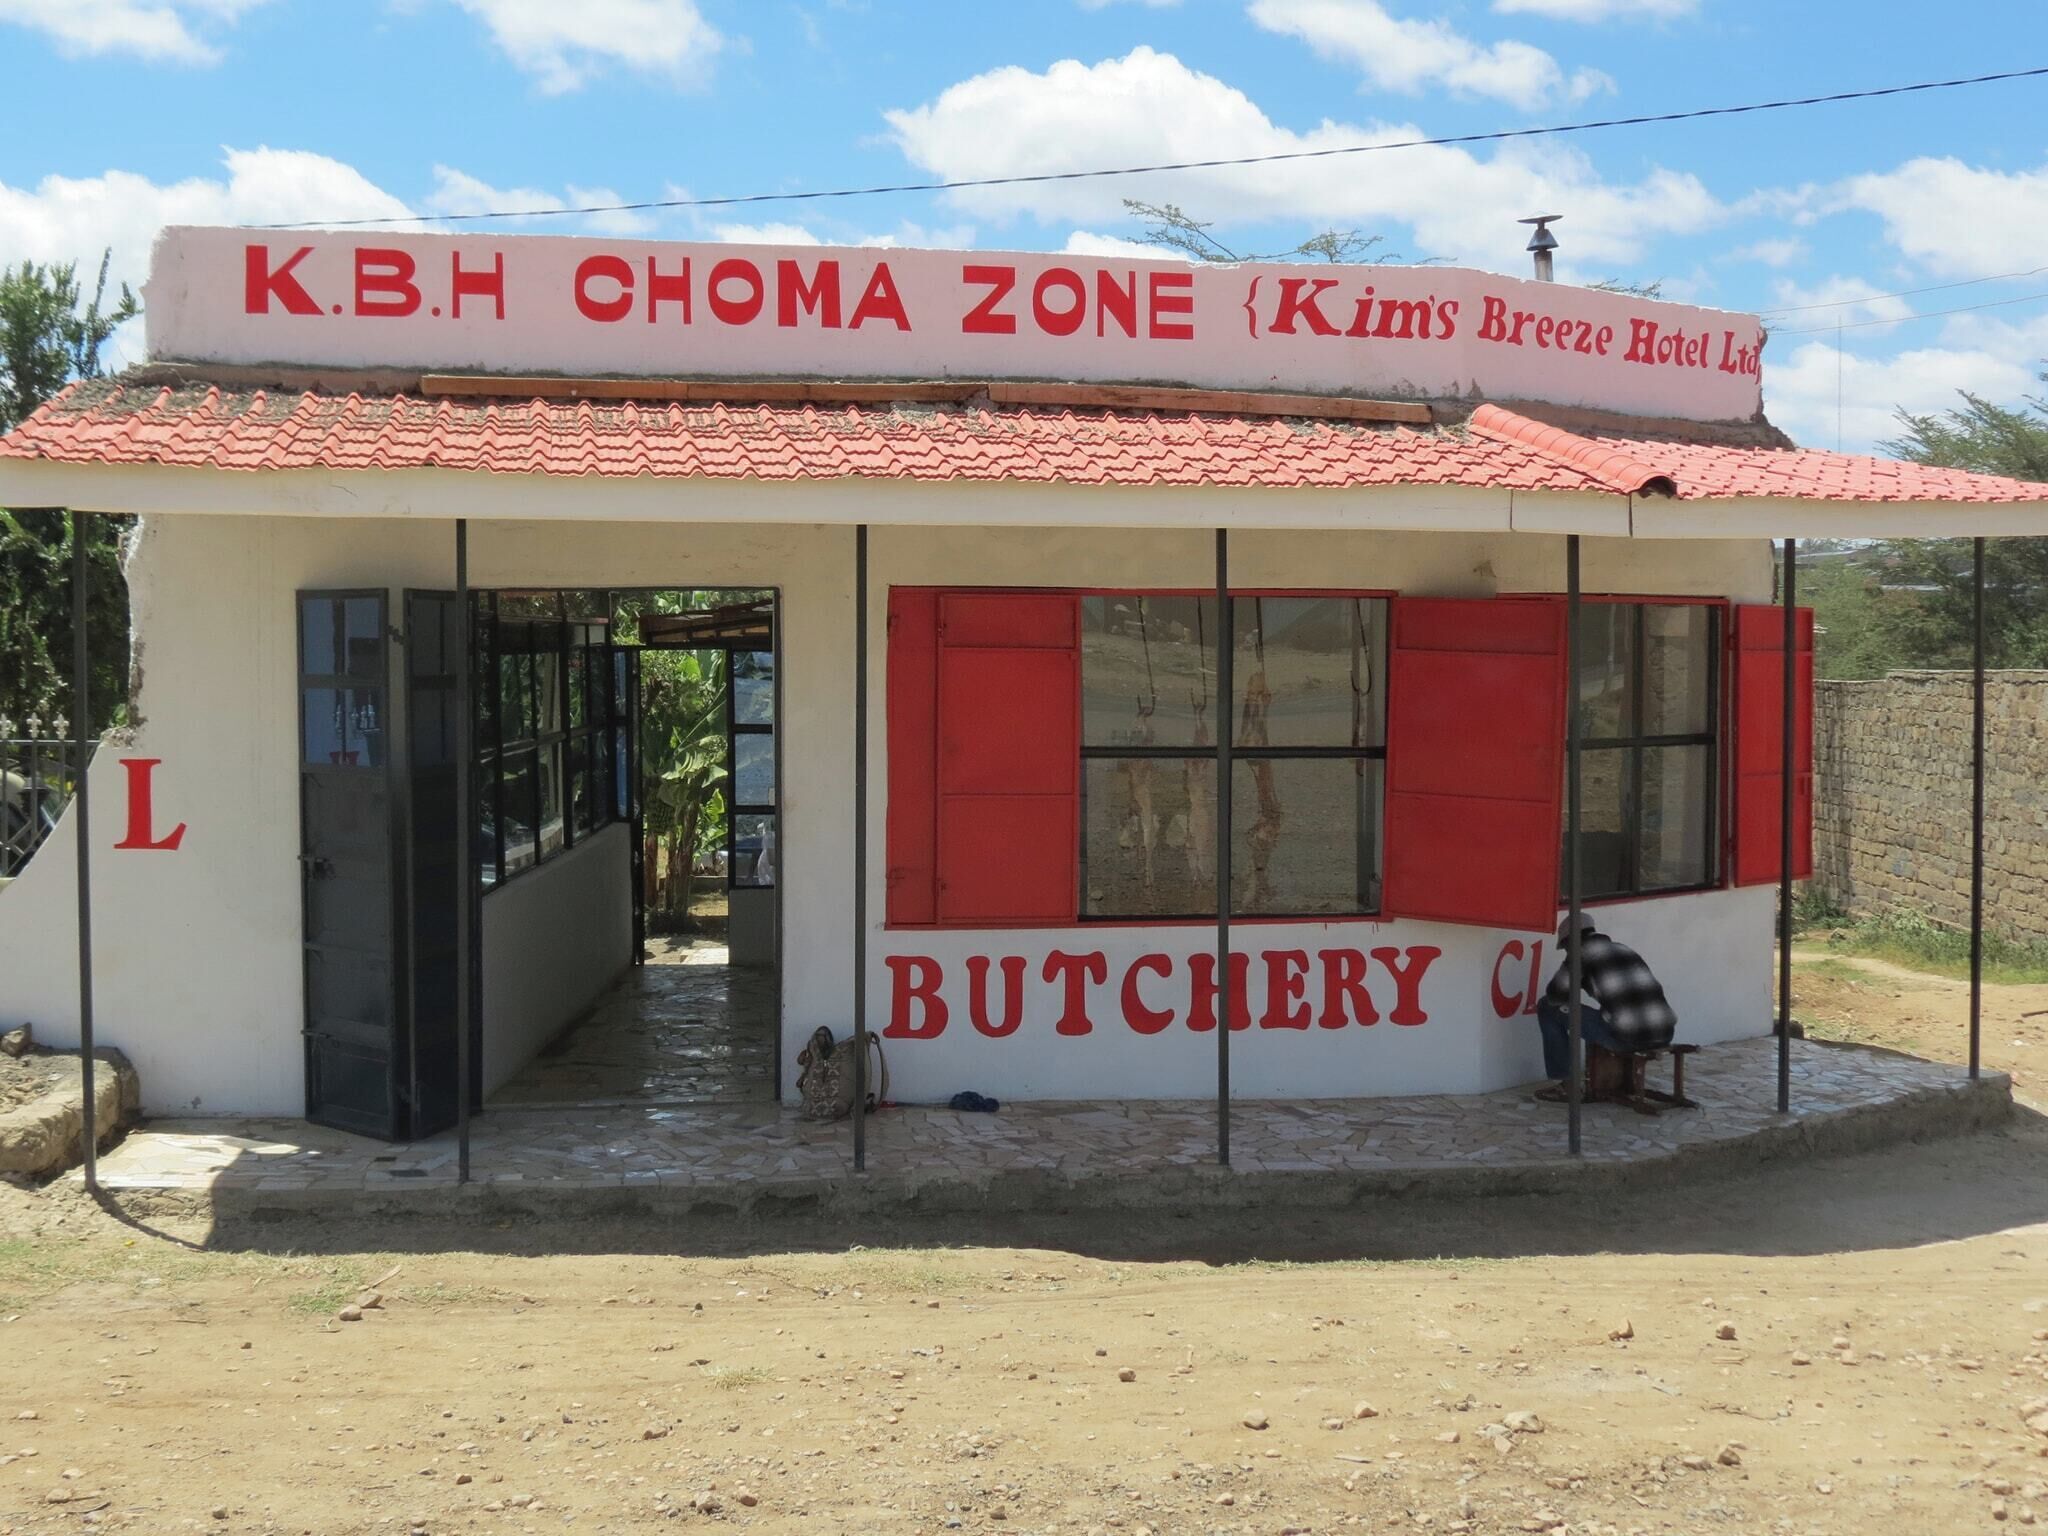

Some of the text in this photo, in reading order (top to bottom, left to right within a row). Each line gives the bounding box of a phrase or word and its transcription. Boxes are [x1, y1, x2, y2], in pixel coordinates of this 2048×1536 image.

[244, 243, 507, 321] K.B.H
[572, 254, 914, 334] CHOMA
[961, 263, 1196, 341] ZONE
[1477, 294, 1616, 357] Breeze
[1622, 316, 1711, 369] Hotel
[112, 757, 188, 852] L
[882, 945, 1443, 1039] BUTCHERY
